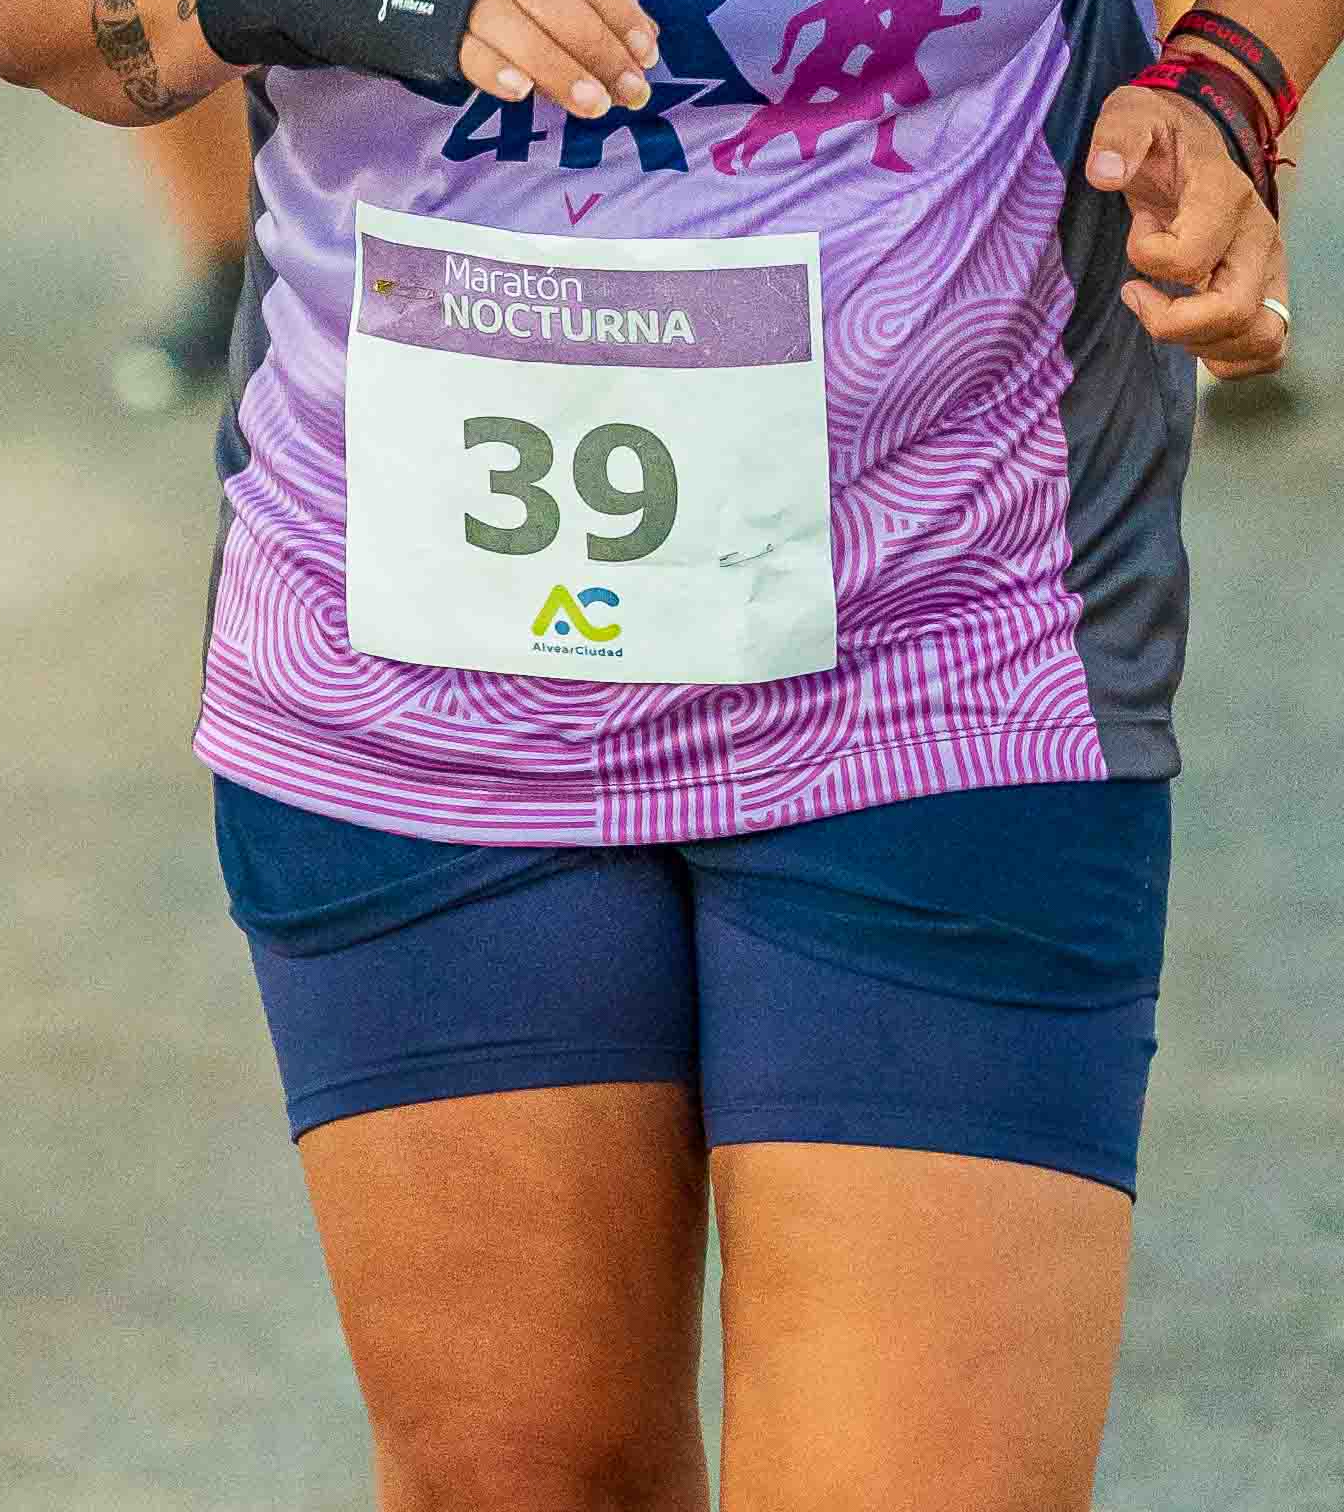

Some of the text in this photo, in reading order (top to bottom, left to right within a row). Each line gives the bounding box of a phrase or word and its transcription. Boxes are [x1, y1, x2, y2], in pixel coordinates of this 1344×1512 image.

[443, 253, 583, 303] Maratón
[441, 293, 696, 347] NOCTURNA
[464, 416, 679, 563] 39
